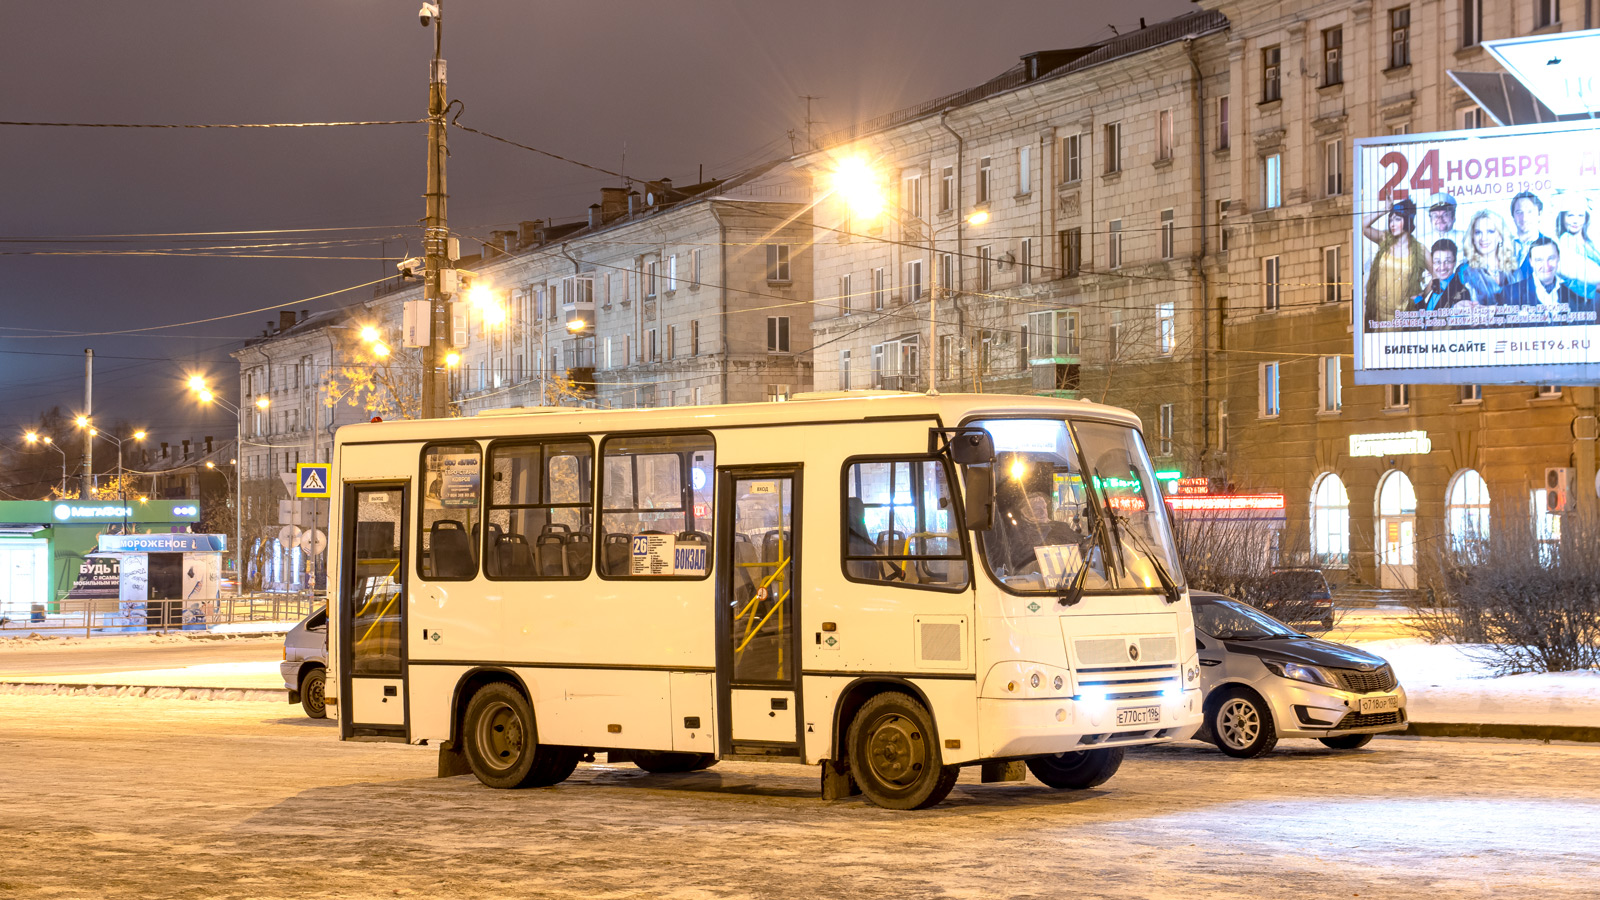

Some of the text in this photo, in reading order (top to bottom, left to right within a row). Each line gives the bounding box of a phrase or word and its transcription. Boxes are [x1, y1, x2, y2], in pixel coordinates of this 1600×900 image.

[1379, 149, 1549, 201] 24 НОЯБРЯ
[1447, 179, 1552, 197] НАЧАЛО В 19:00
[1384, 341, 1486, 355] БИЛЕТЫ НА САЙТЕ
[1510, 339, 1591, 352] BILET96.RU
[120, 540, 187, 548] МОРОЖЕНОЕ
[633, 537, 648, 554] 26
[675, 548, 705, 570] ВОКЗАЛ
[79, 564, 111, 575] БУДЬ
[1118, 707, 1159, 723] Е770СТ 196
